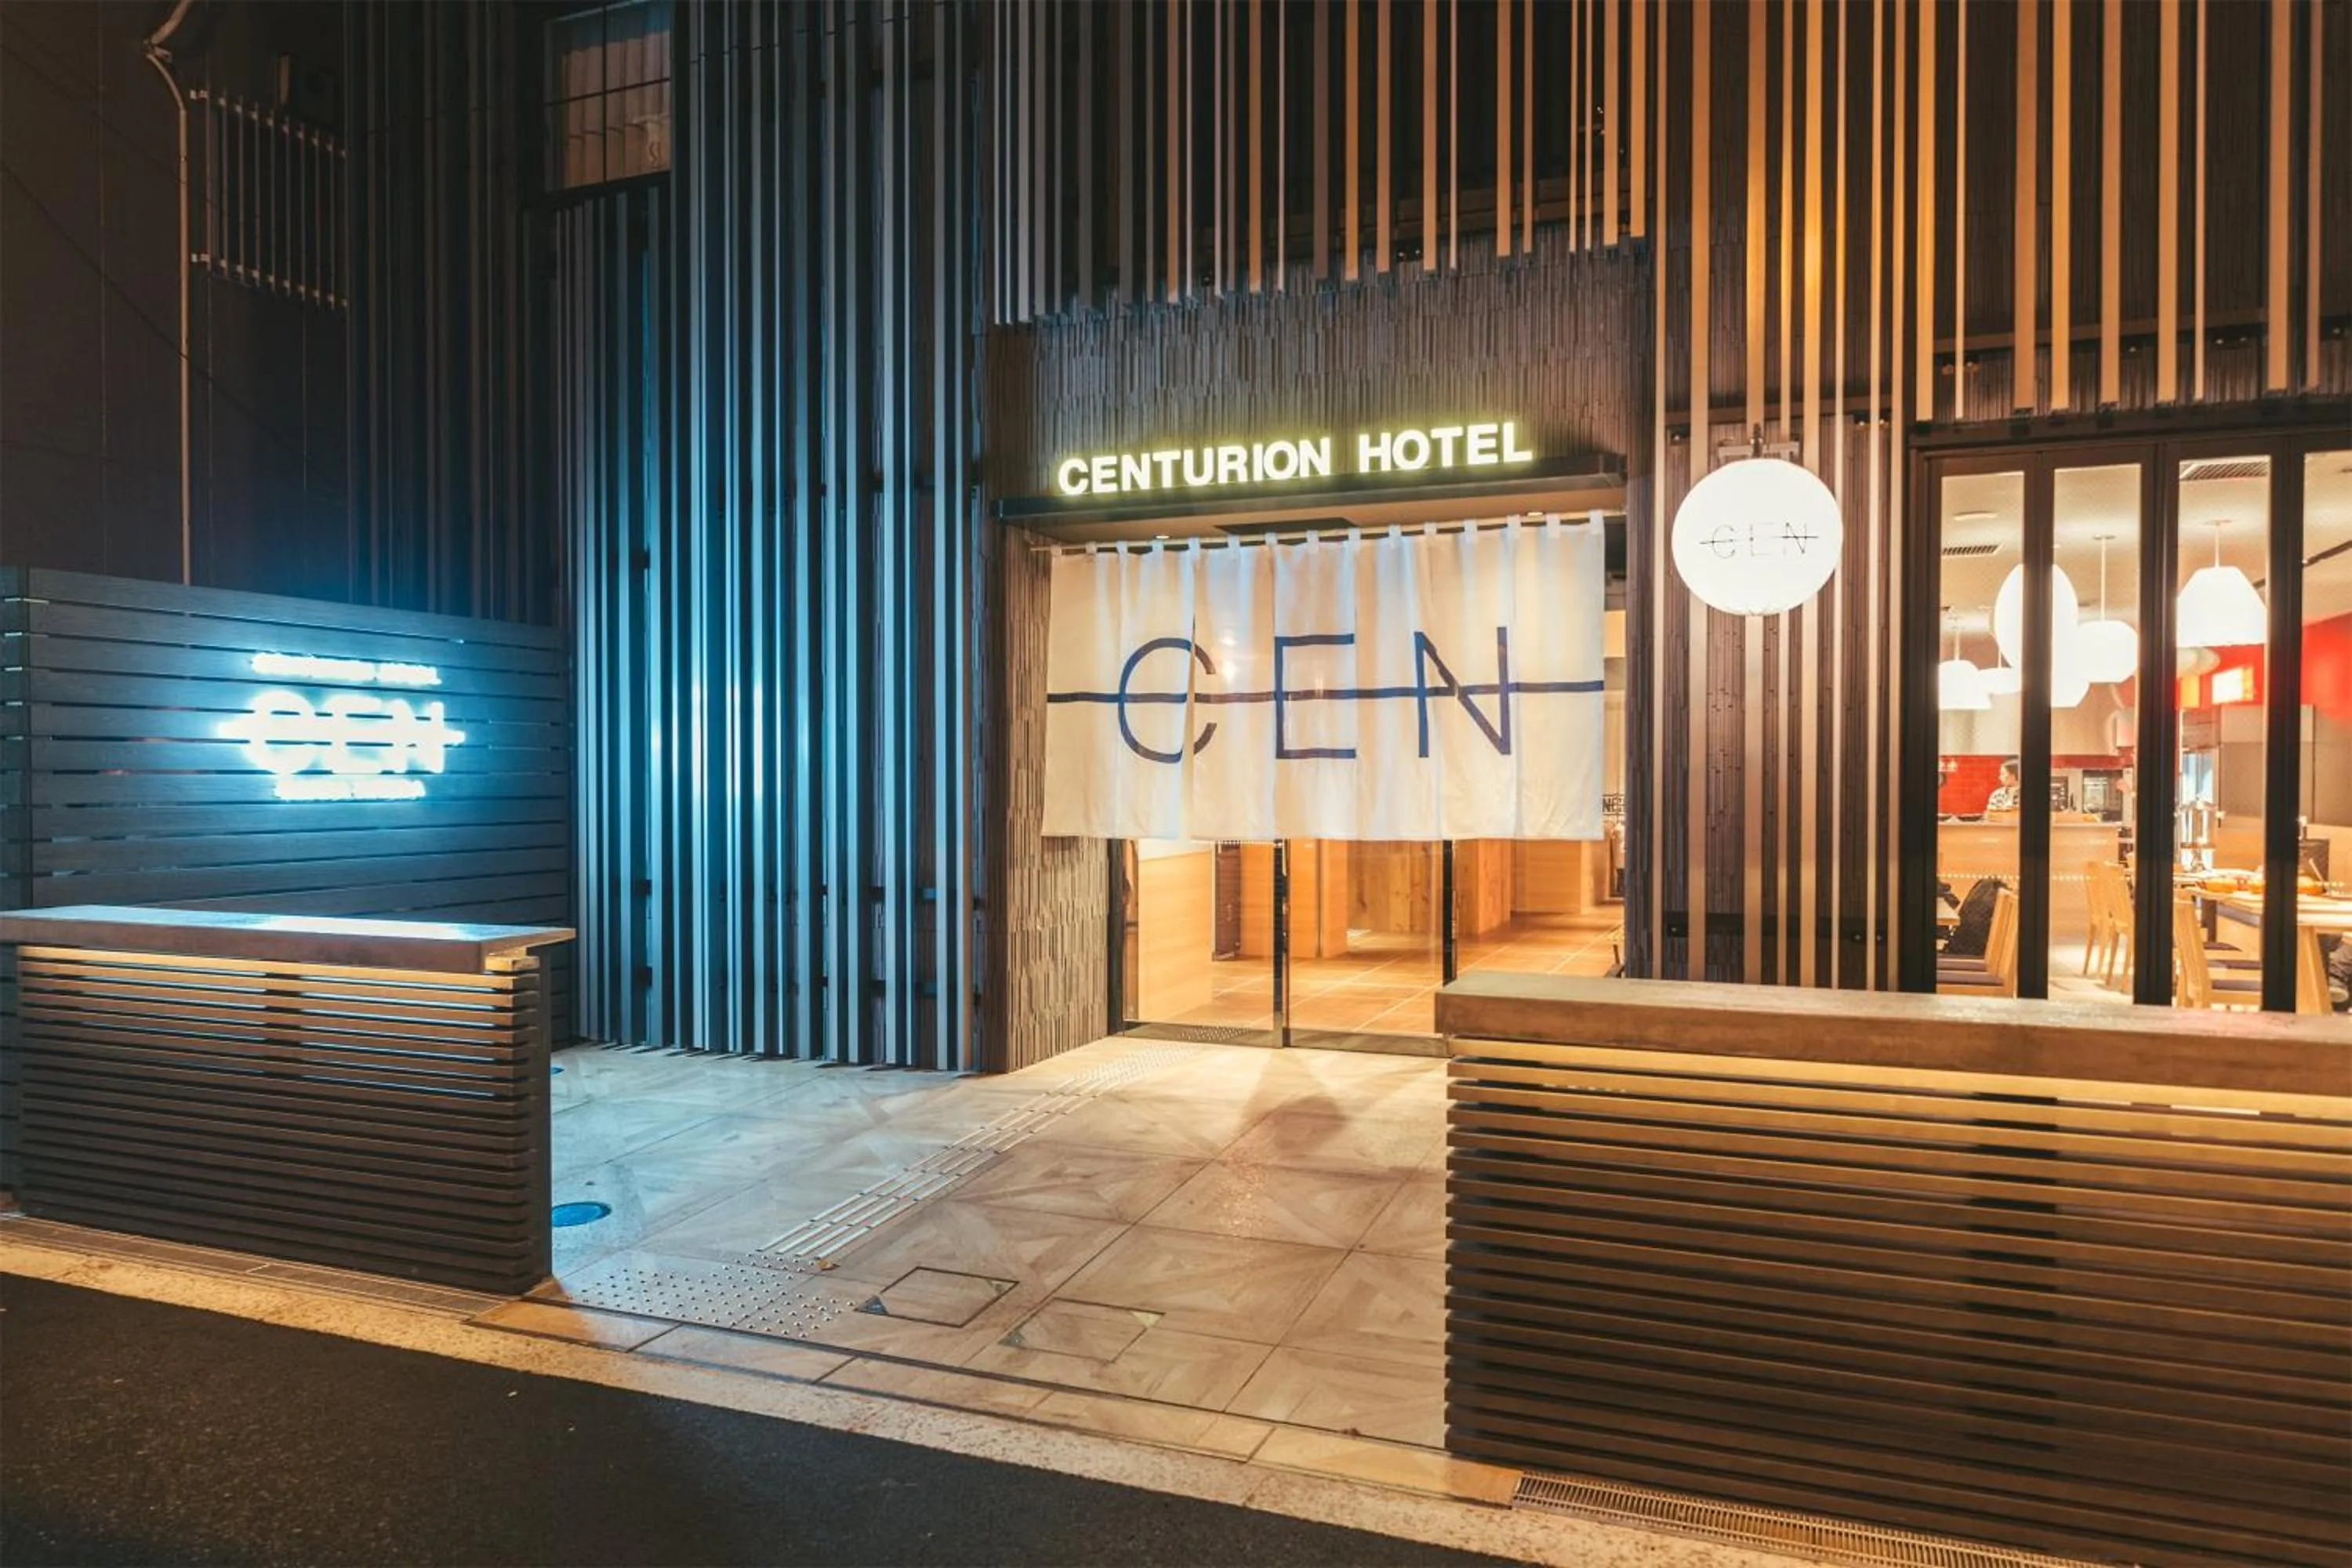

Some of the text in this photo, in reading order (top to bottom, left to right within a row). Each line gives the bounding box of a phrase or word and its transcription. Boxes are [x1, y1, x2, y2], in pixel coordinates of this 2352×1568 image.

[1058, 422, 1534, 495] CENTURION HOTEL
[1706, 521, 1811, 559] CEN
[1117, 626, 1512, 764] CEN
